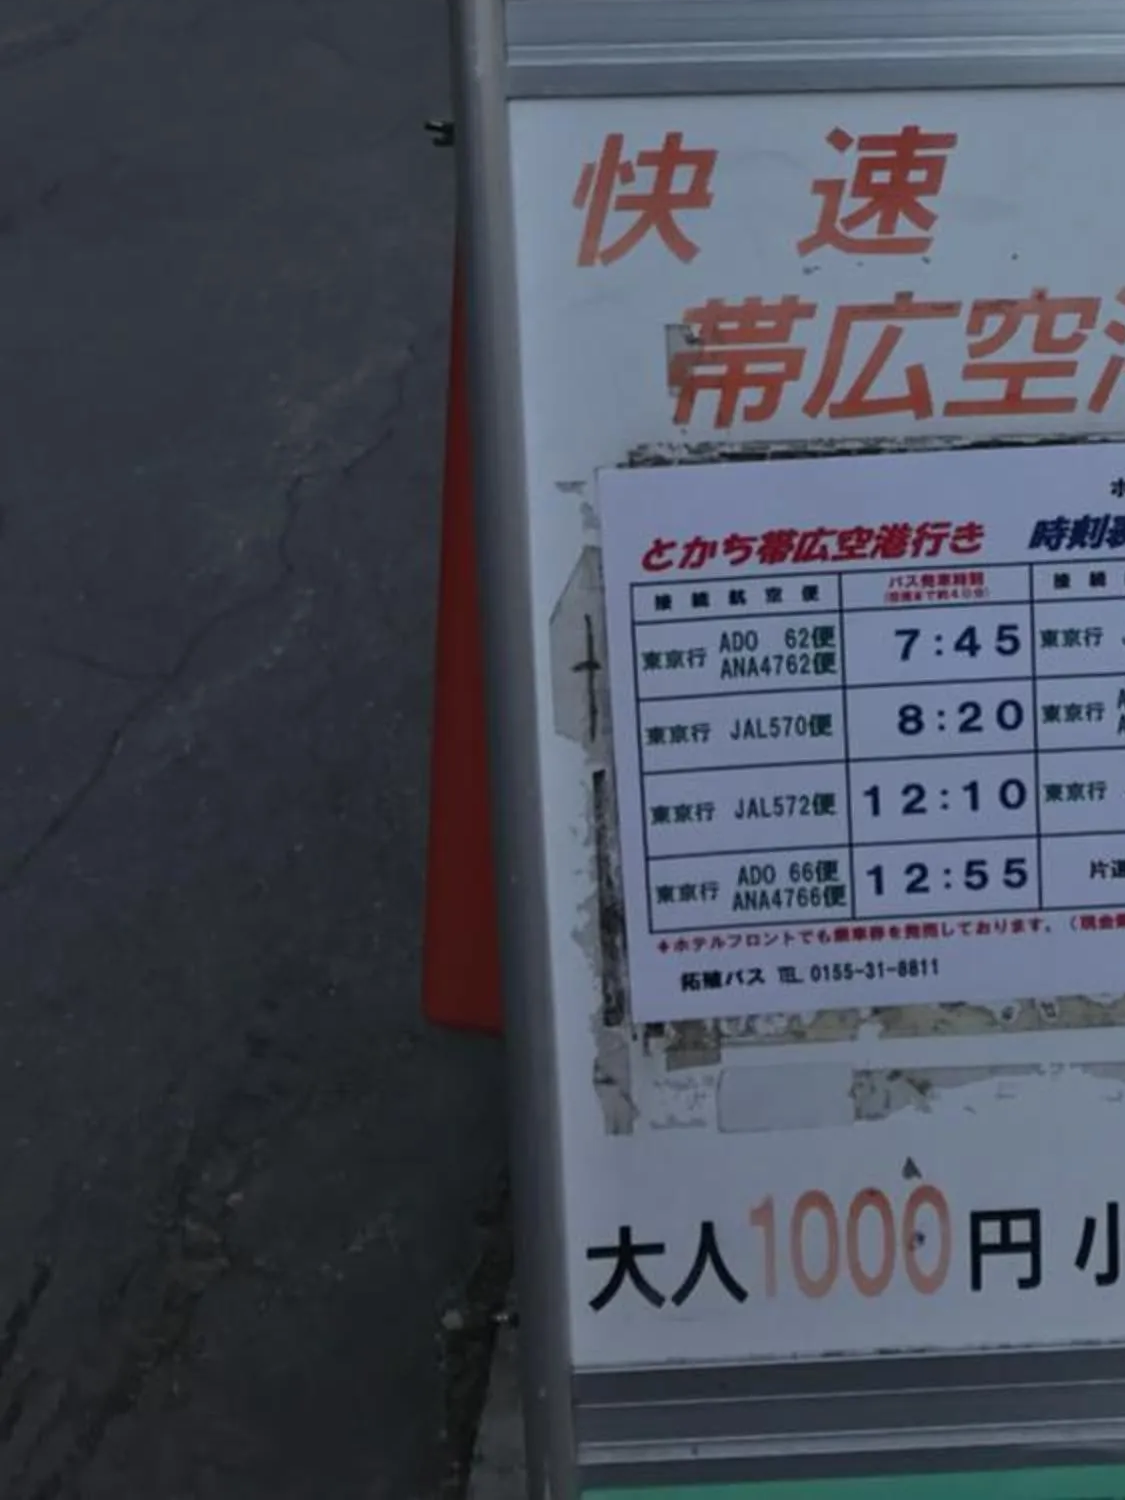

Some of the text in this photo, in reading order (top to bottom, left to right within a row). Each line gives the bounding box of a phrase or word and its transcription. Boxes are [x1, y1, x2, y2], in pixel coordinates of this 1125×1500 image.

[641, 521, 985, 572] とかち帯広空港行き
[718, 624, 836, 653] ADO 62便
[893, 623, 1022, 662] 7:45
[1040, 625, 1103, 649] 東京行
[642, 647, 707, 671] 東京行
[720, 650, 837, 680] ANA4762便
[897, 699, 1024, 736] 8:20
[1041, 701, 1106, 725] 東京行
[646, 712, 833, 746] 東京行 JAL570便
[863, 778, 1028, 818] 12:10
[1043, 779, 1108, 803] 東京行
[650, 792, 837, 826] 東京行 JAL572便
[736, 859, 841, 887] ADO 66便
[866, 857, 1028, 896] 12:55
[655, 880, 720, 905] 東京行
[732, 884, 847, 913] ANA4766便
